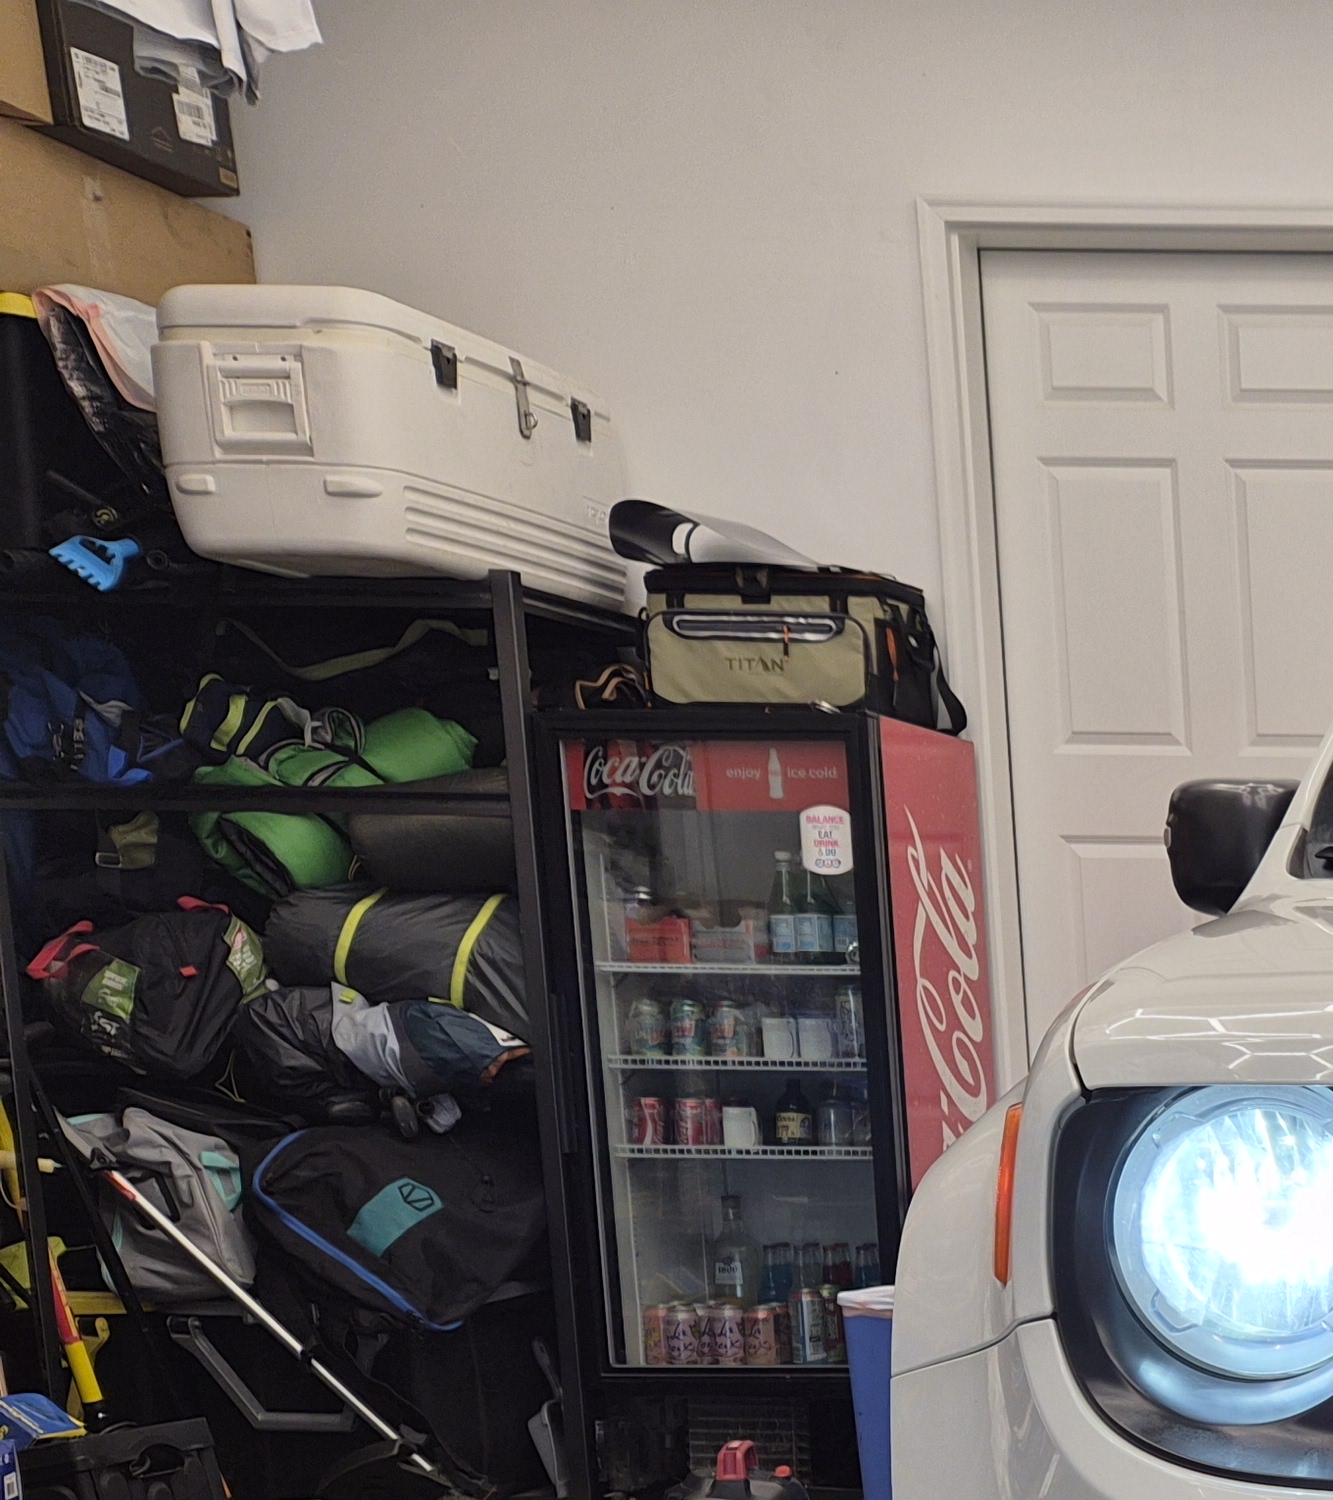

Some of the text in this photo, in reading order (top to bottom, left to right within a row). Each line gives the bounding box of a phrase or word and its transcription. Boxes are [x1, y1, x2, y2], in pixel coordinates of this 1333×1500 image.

[724, 655, 784, 672] TITAN
[583, 744, 697, 800] Coca-Cola
[726, 766, 761, 781] enjoy
[810, 766, 837, 779] cold
[806, 815, 844, 824] BALANCE
